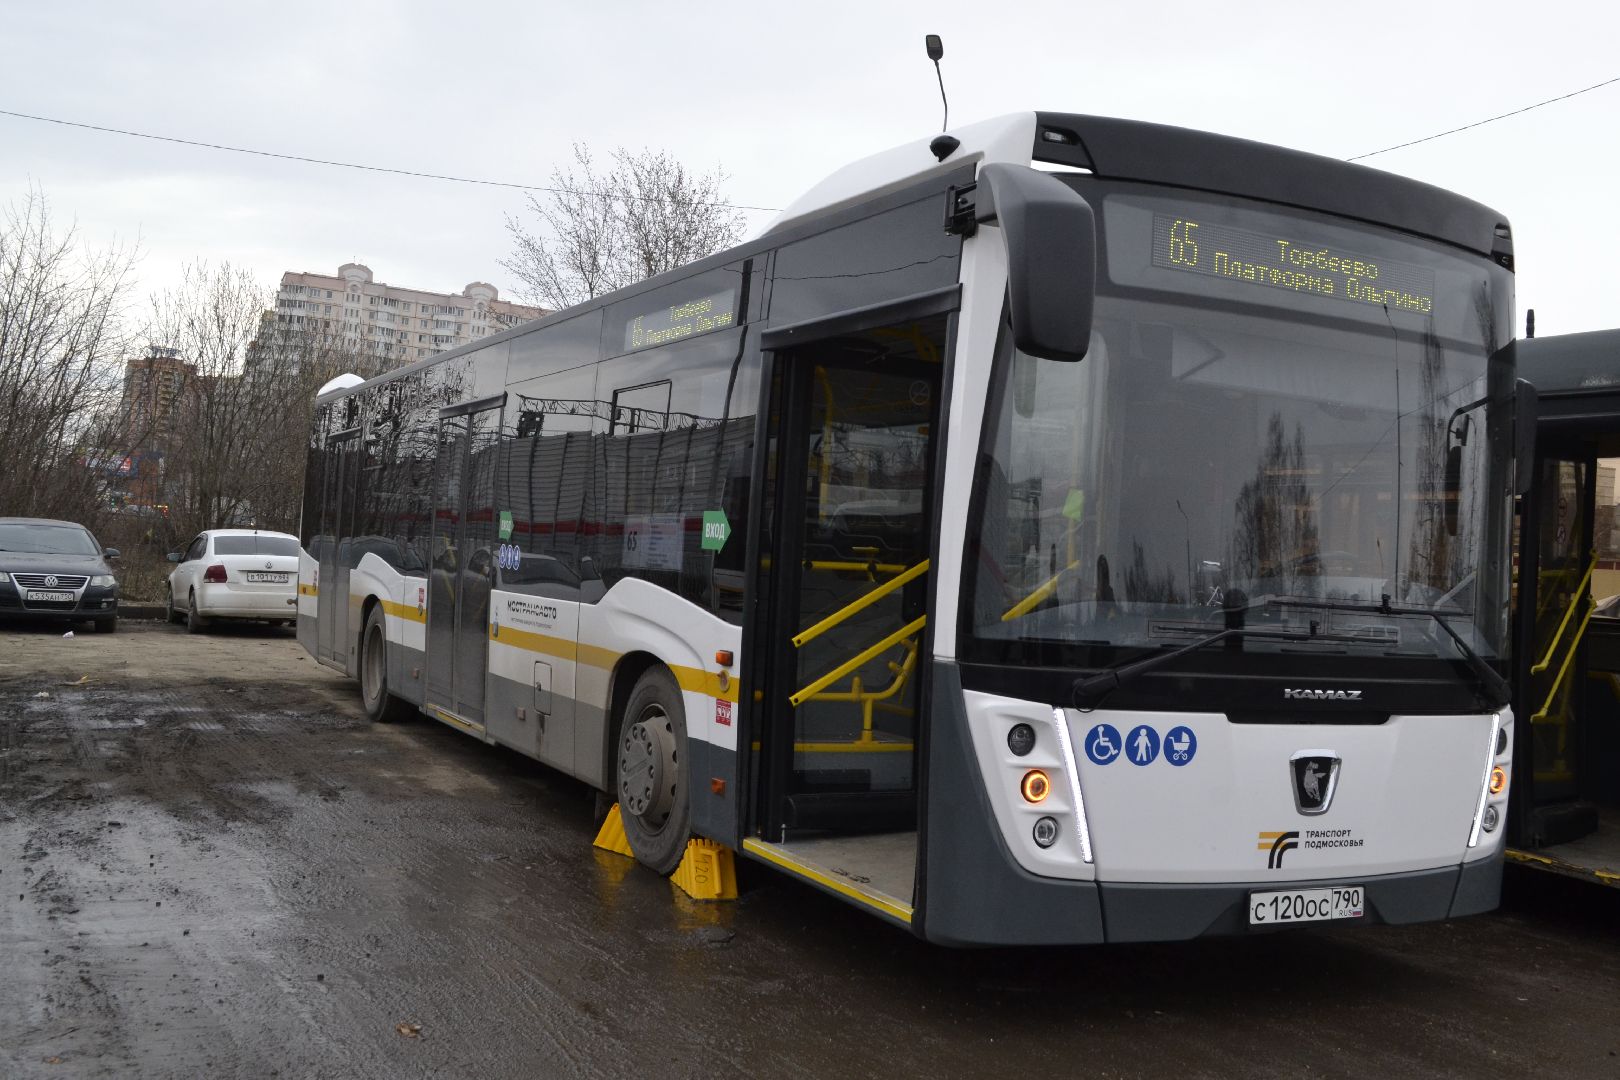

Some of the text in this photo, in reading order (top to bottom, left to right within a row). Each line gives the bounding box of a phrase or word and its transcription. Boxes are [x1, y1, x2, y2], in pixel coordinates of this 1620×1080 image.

[1169, 219, 1199, 267] 65
[1277, 240, 1378, 279] Торбеево
[1214, 252, 1432, 313] Платформа Ольгино
[627, 530, 638, 552] 65
[705, 522, 725, 541] ВХОД
[1284, 688, 1363, 701] KAMAZ
[1305, 829, 1352, 838] ТРАНСПОРТ
[1304, 839, 1364, 849] ПОДМОСКОВЬЯ
[1333, 889, 1360, 909] 790
